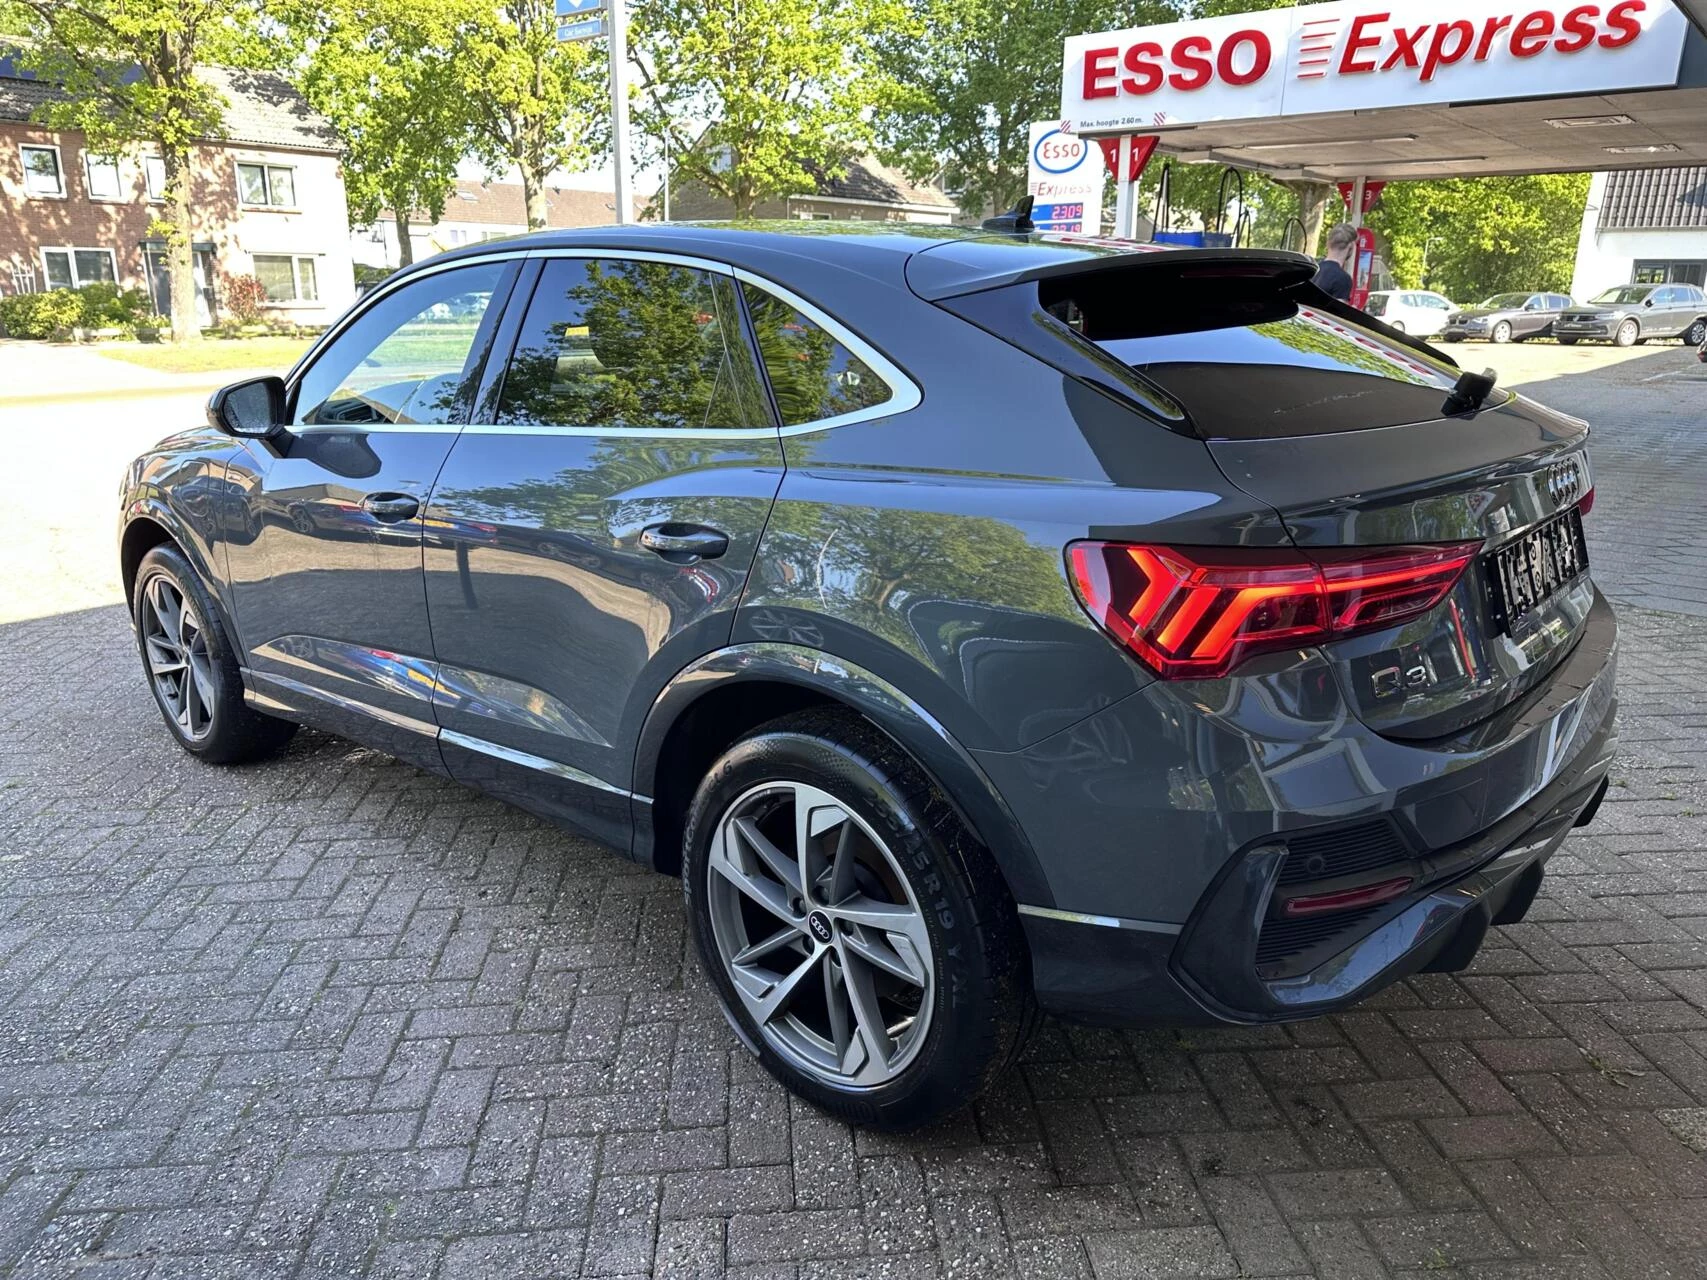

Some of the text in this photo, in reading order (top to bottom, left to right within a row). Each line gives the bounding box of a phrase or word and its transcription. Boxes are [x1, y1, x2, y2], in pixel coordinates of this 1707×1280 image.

[1083, 0, 1647, 100] ESSO Express
[1096, 119, 1119, 127] hoogte
[1110, 149, 1117, 163] 1
[1132, 147, 1139, 161] 1
[1037, 182, 1092, 198] Express
[1346, 190, 1353, 200] 3
[1365, 190, 1372, 200] 3
[1371, 665, 1427, 698] Q3
